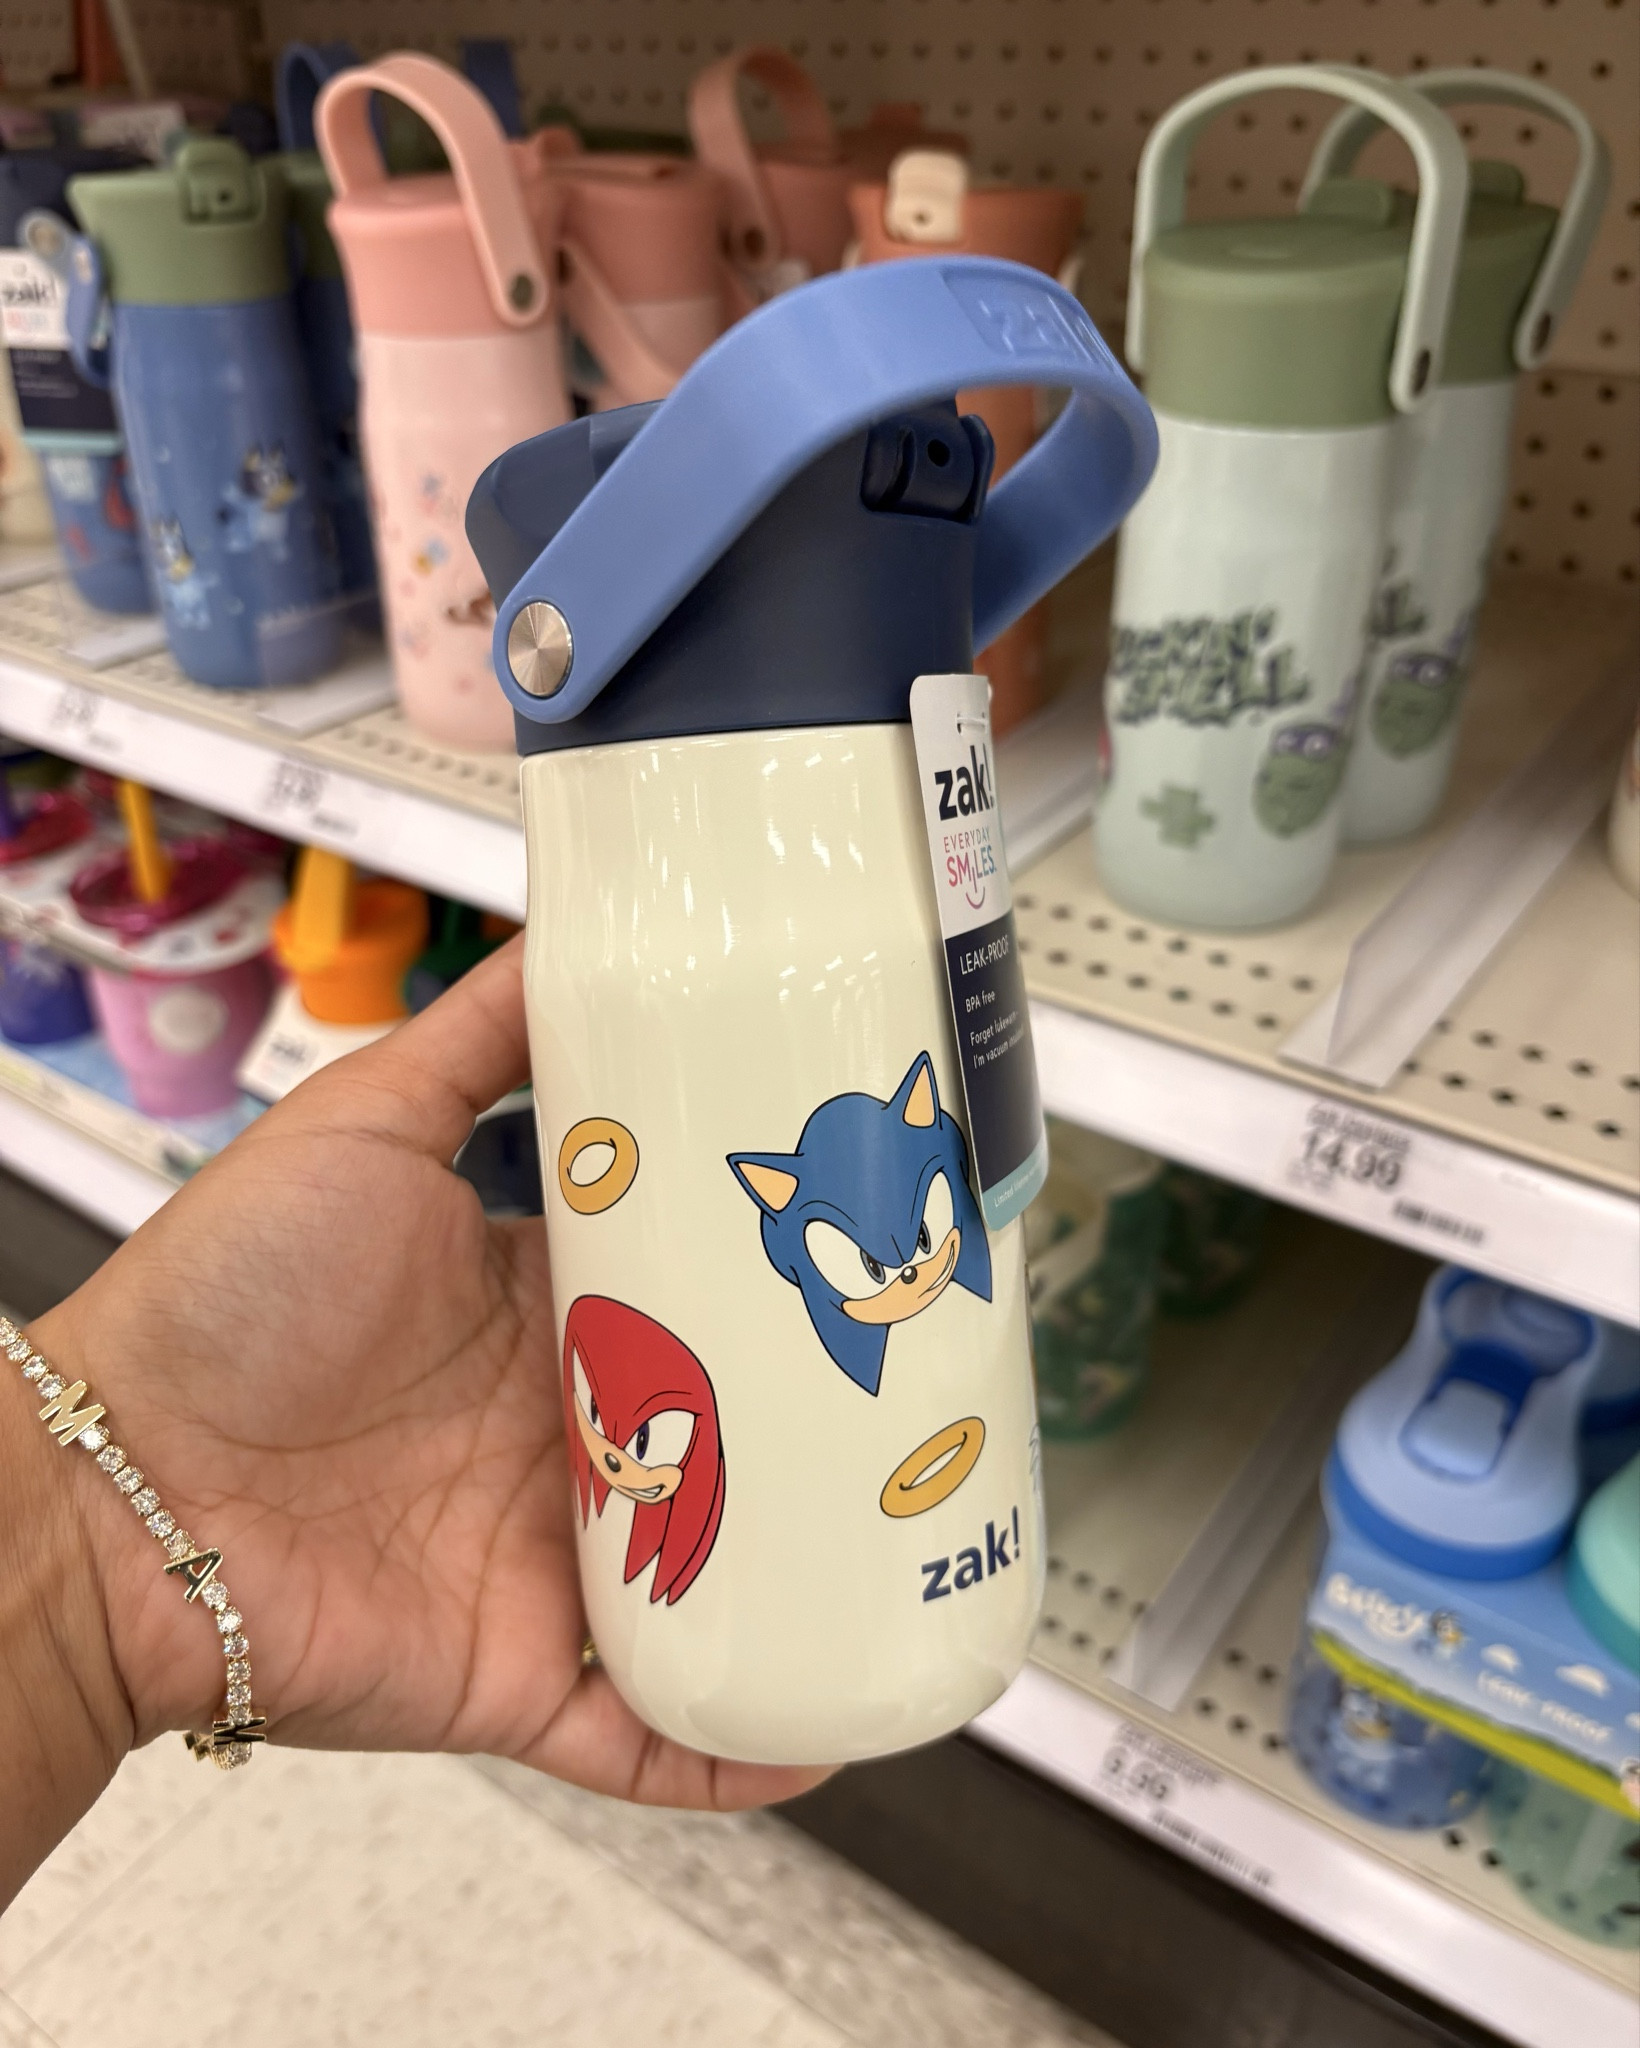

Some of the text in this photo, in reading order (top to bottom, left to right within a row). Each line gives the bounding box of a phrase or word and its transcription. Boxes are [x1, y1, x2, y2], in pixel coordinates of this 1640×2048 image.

[934, 743, 995, 822] zak!
[943, 825, 991, 854] EVERYDAY
[965, 988, 996, 1013] BPA free
[970, 1024, 994, 1047] Forget
[921, 1504, 1020, 1603] zak!
